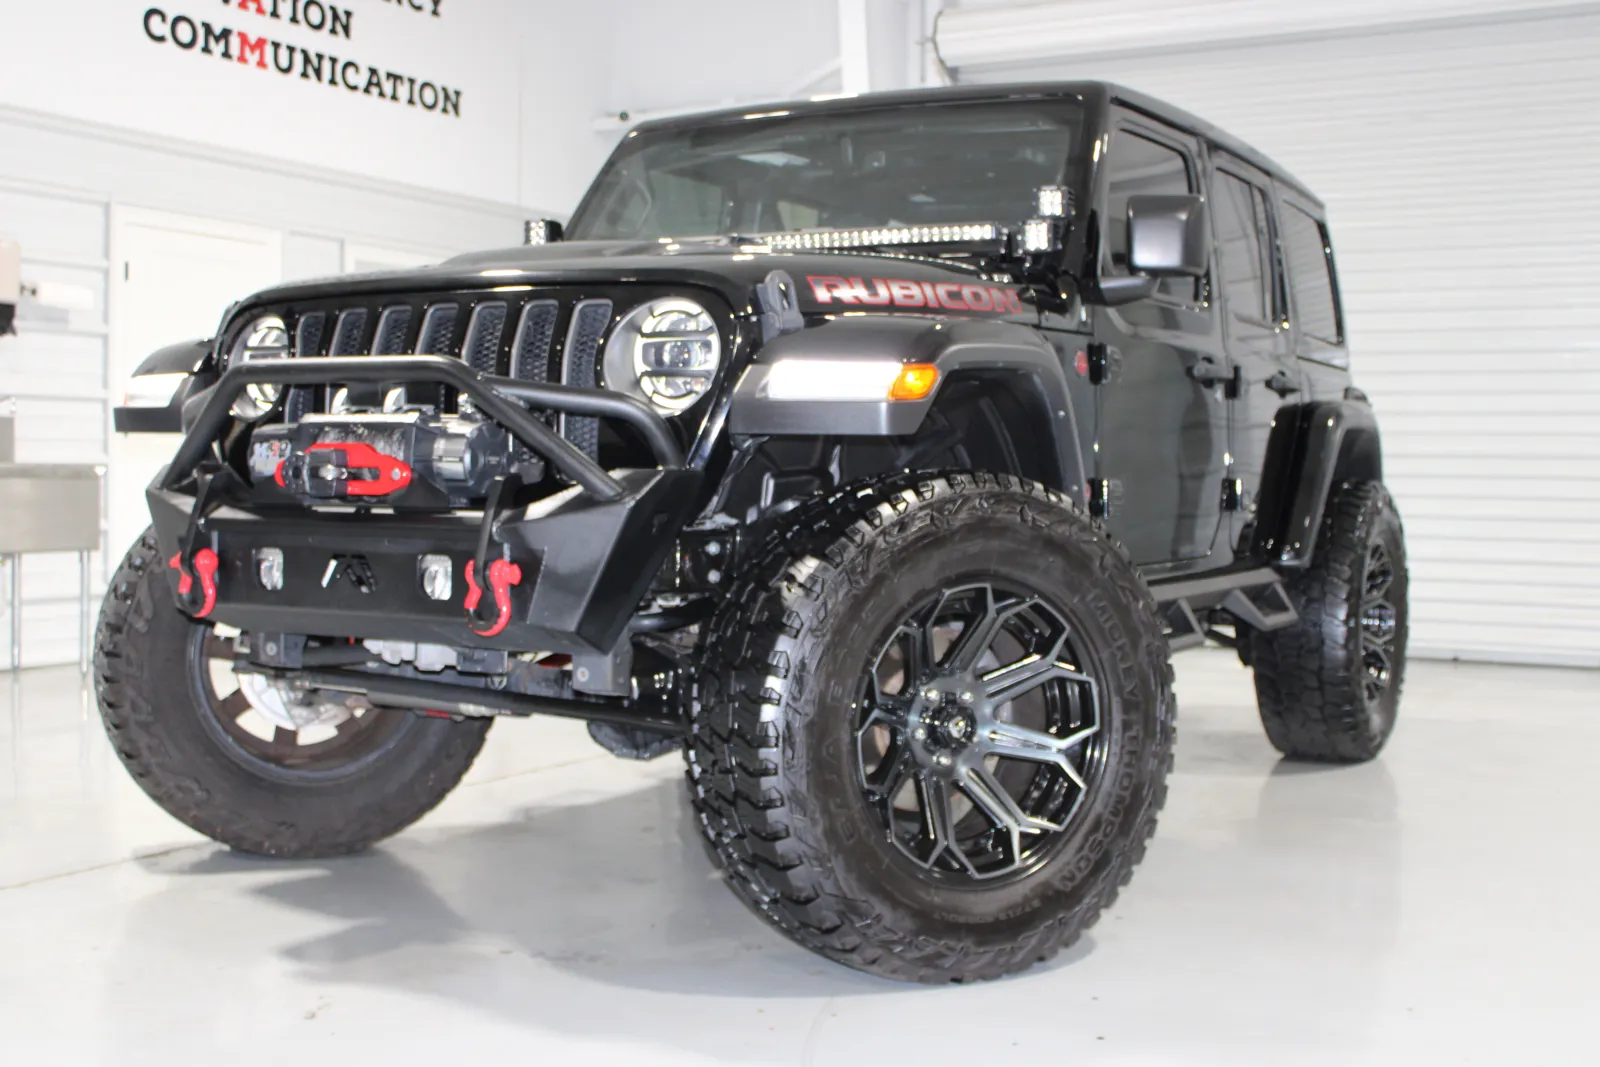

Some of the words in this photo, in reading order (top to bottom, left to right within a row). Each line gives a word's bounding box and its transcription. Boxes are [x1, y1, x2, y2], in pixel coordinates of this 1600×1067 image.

[143, 8, 462, 117] COMMUNICATION
[222, 0, 353, 39] TION
[805, 275, 1022, 314] RUBICON
[1088, 591, 1143, 700] MICKEY
[1054, 725, 1141, 894] THOMPSON
